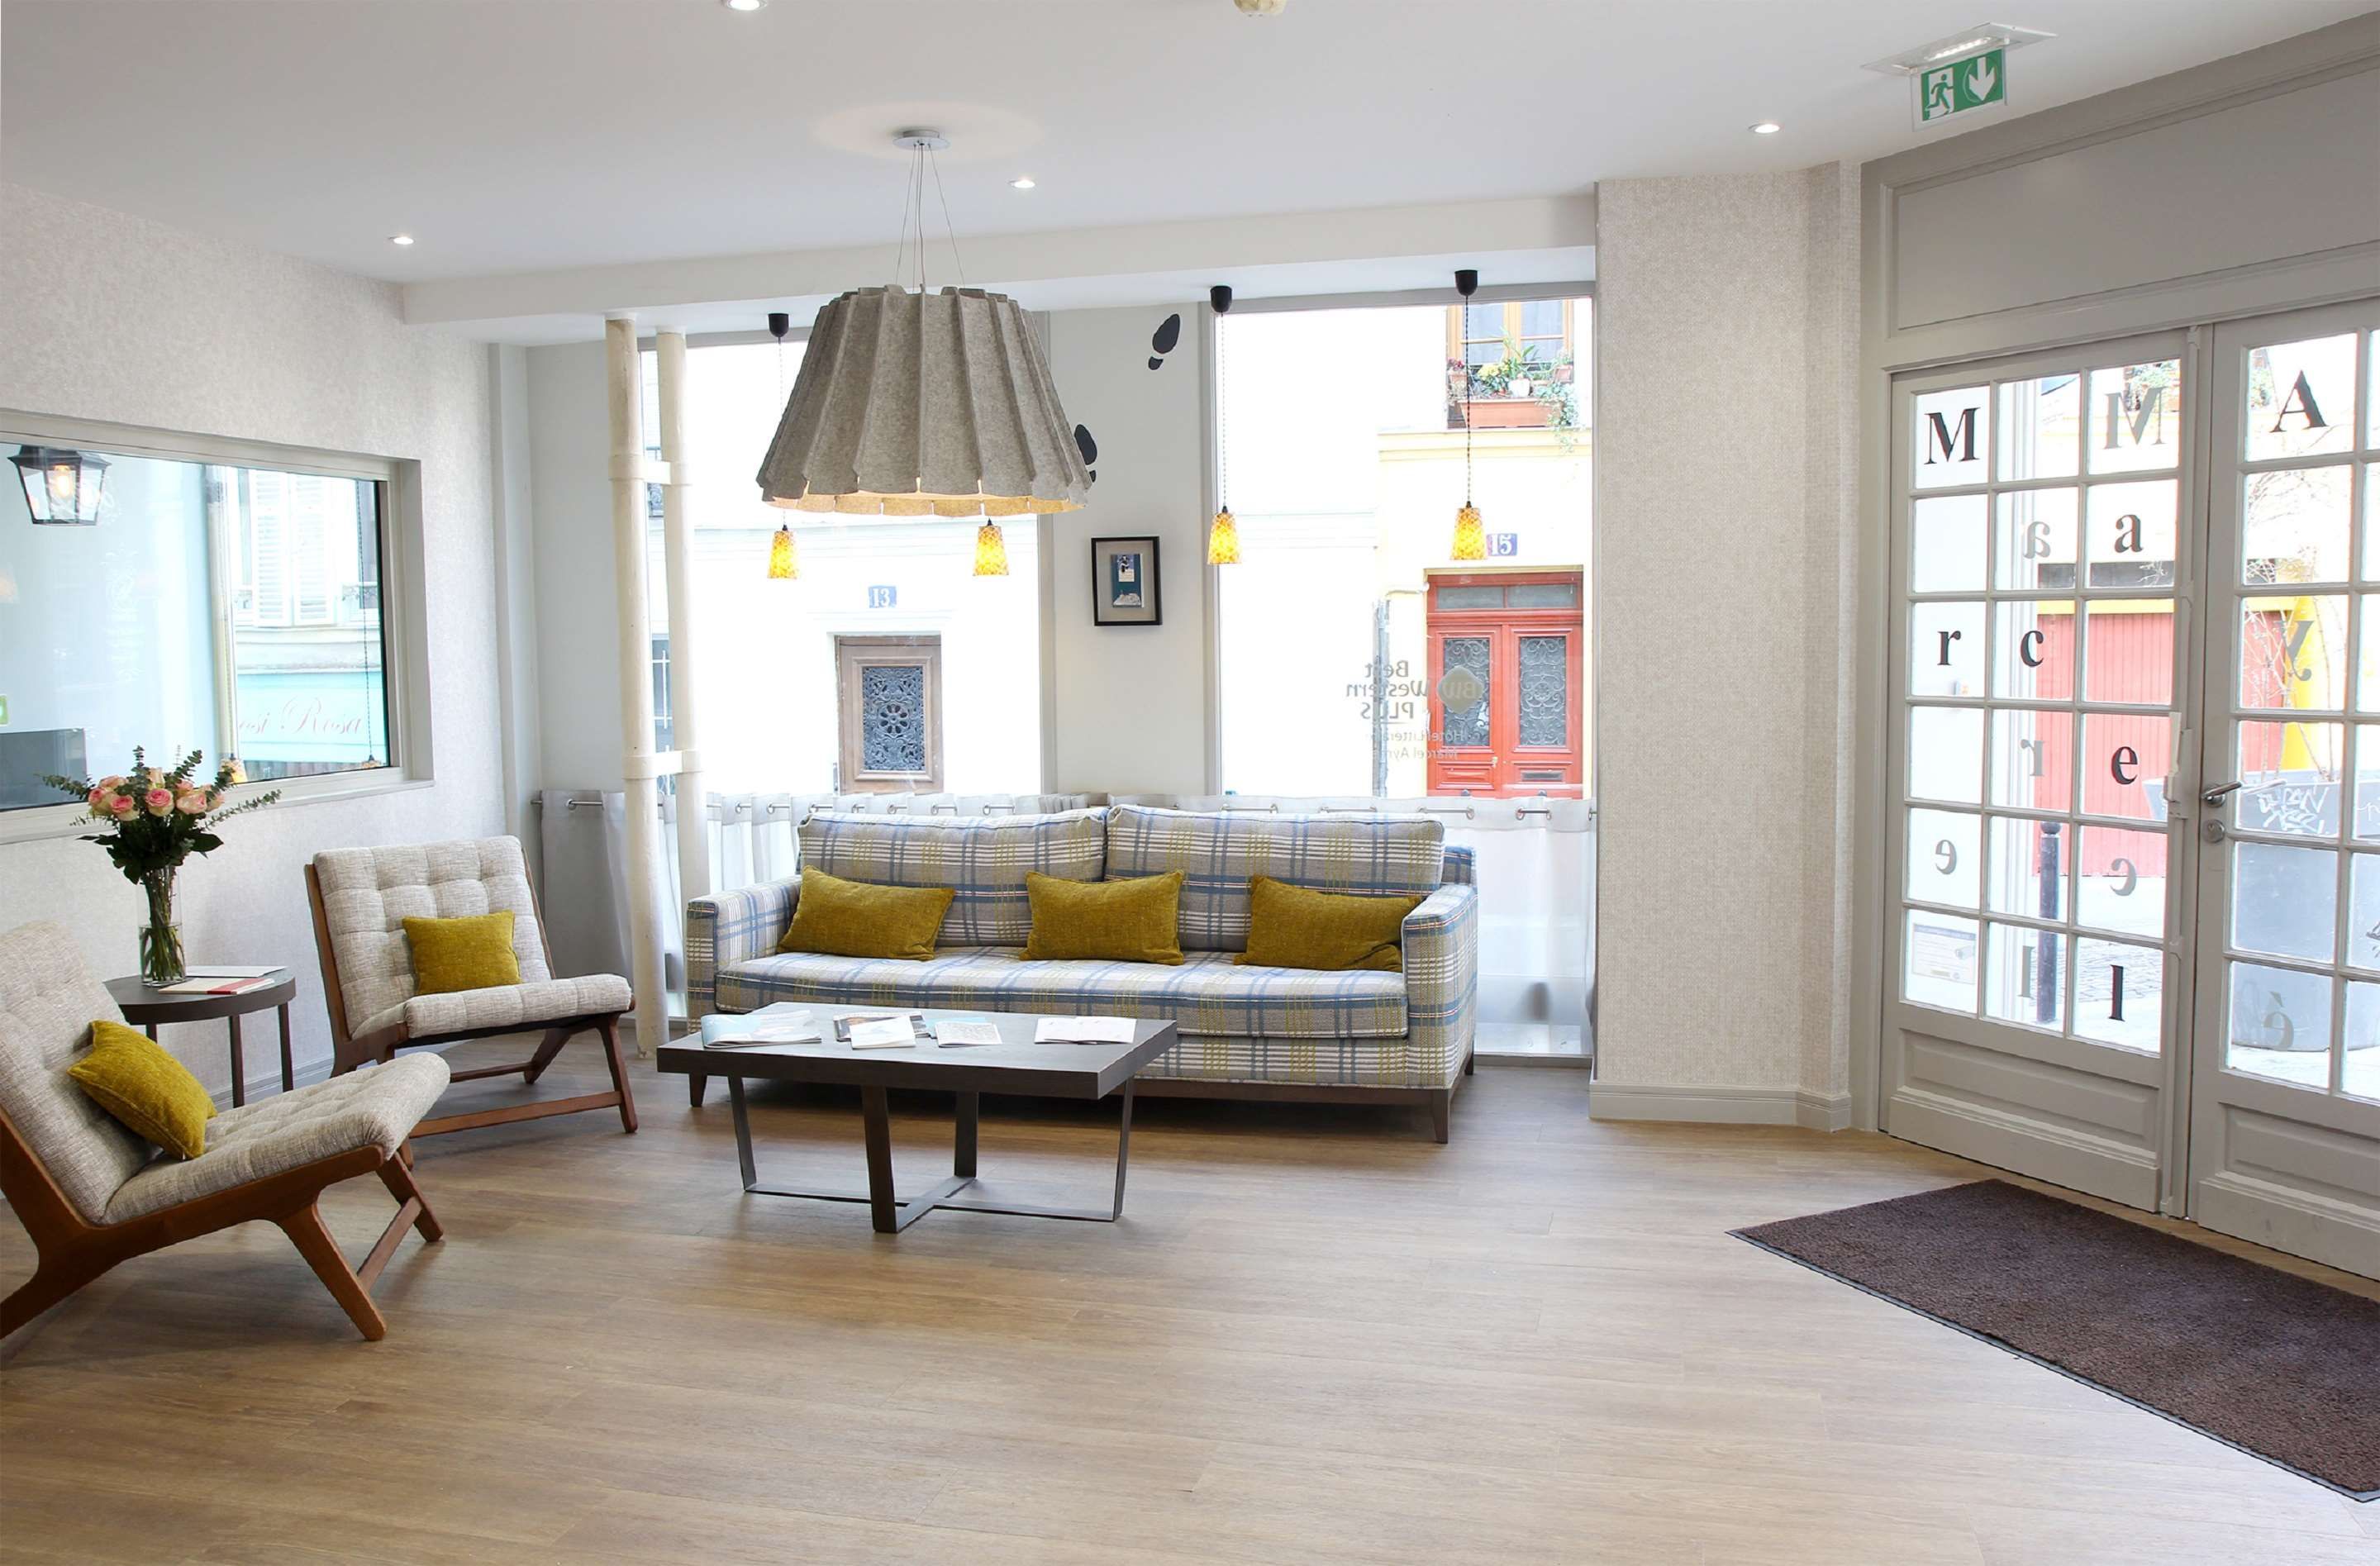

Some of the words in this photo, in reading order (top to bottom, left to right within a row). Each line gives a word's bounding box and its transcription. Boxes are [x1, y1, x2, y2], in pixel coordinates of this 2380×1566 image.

[2269, 369, 2330, 433] A
[1924, 407, 1980, 465] M
[1491, 534, 1512, 555] 15
[2114, 514, 2144, 554] a
[872, 587, 890, 607] 13
[1937, 630, 1961, 666] r
[2020, 630, 2044, 668] c
[2111, 745, 2139, 785] e
